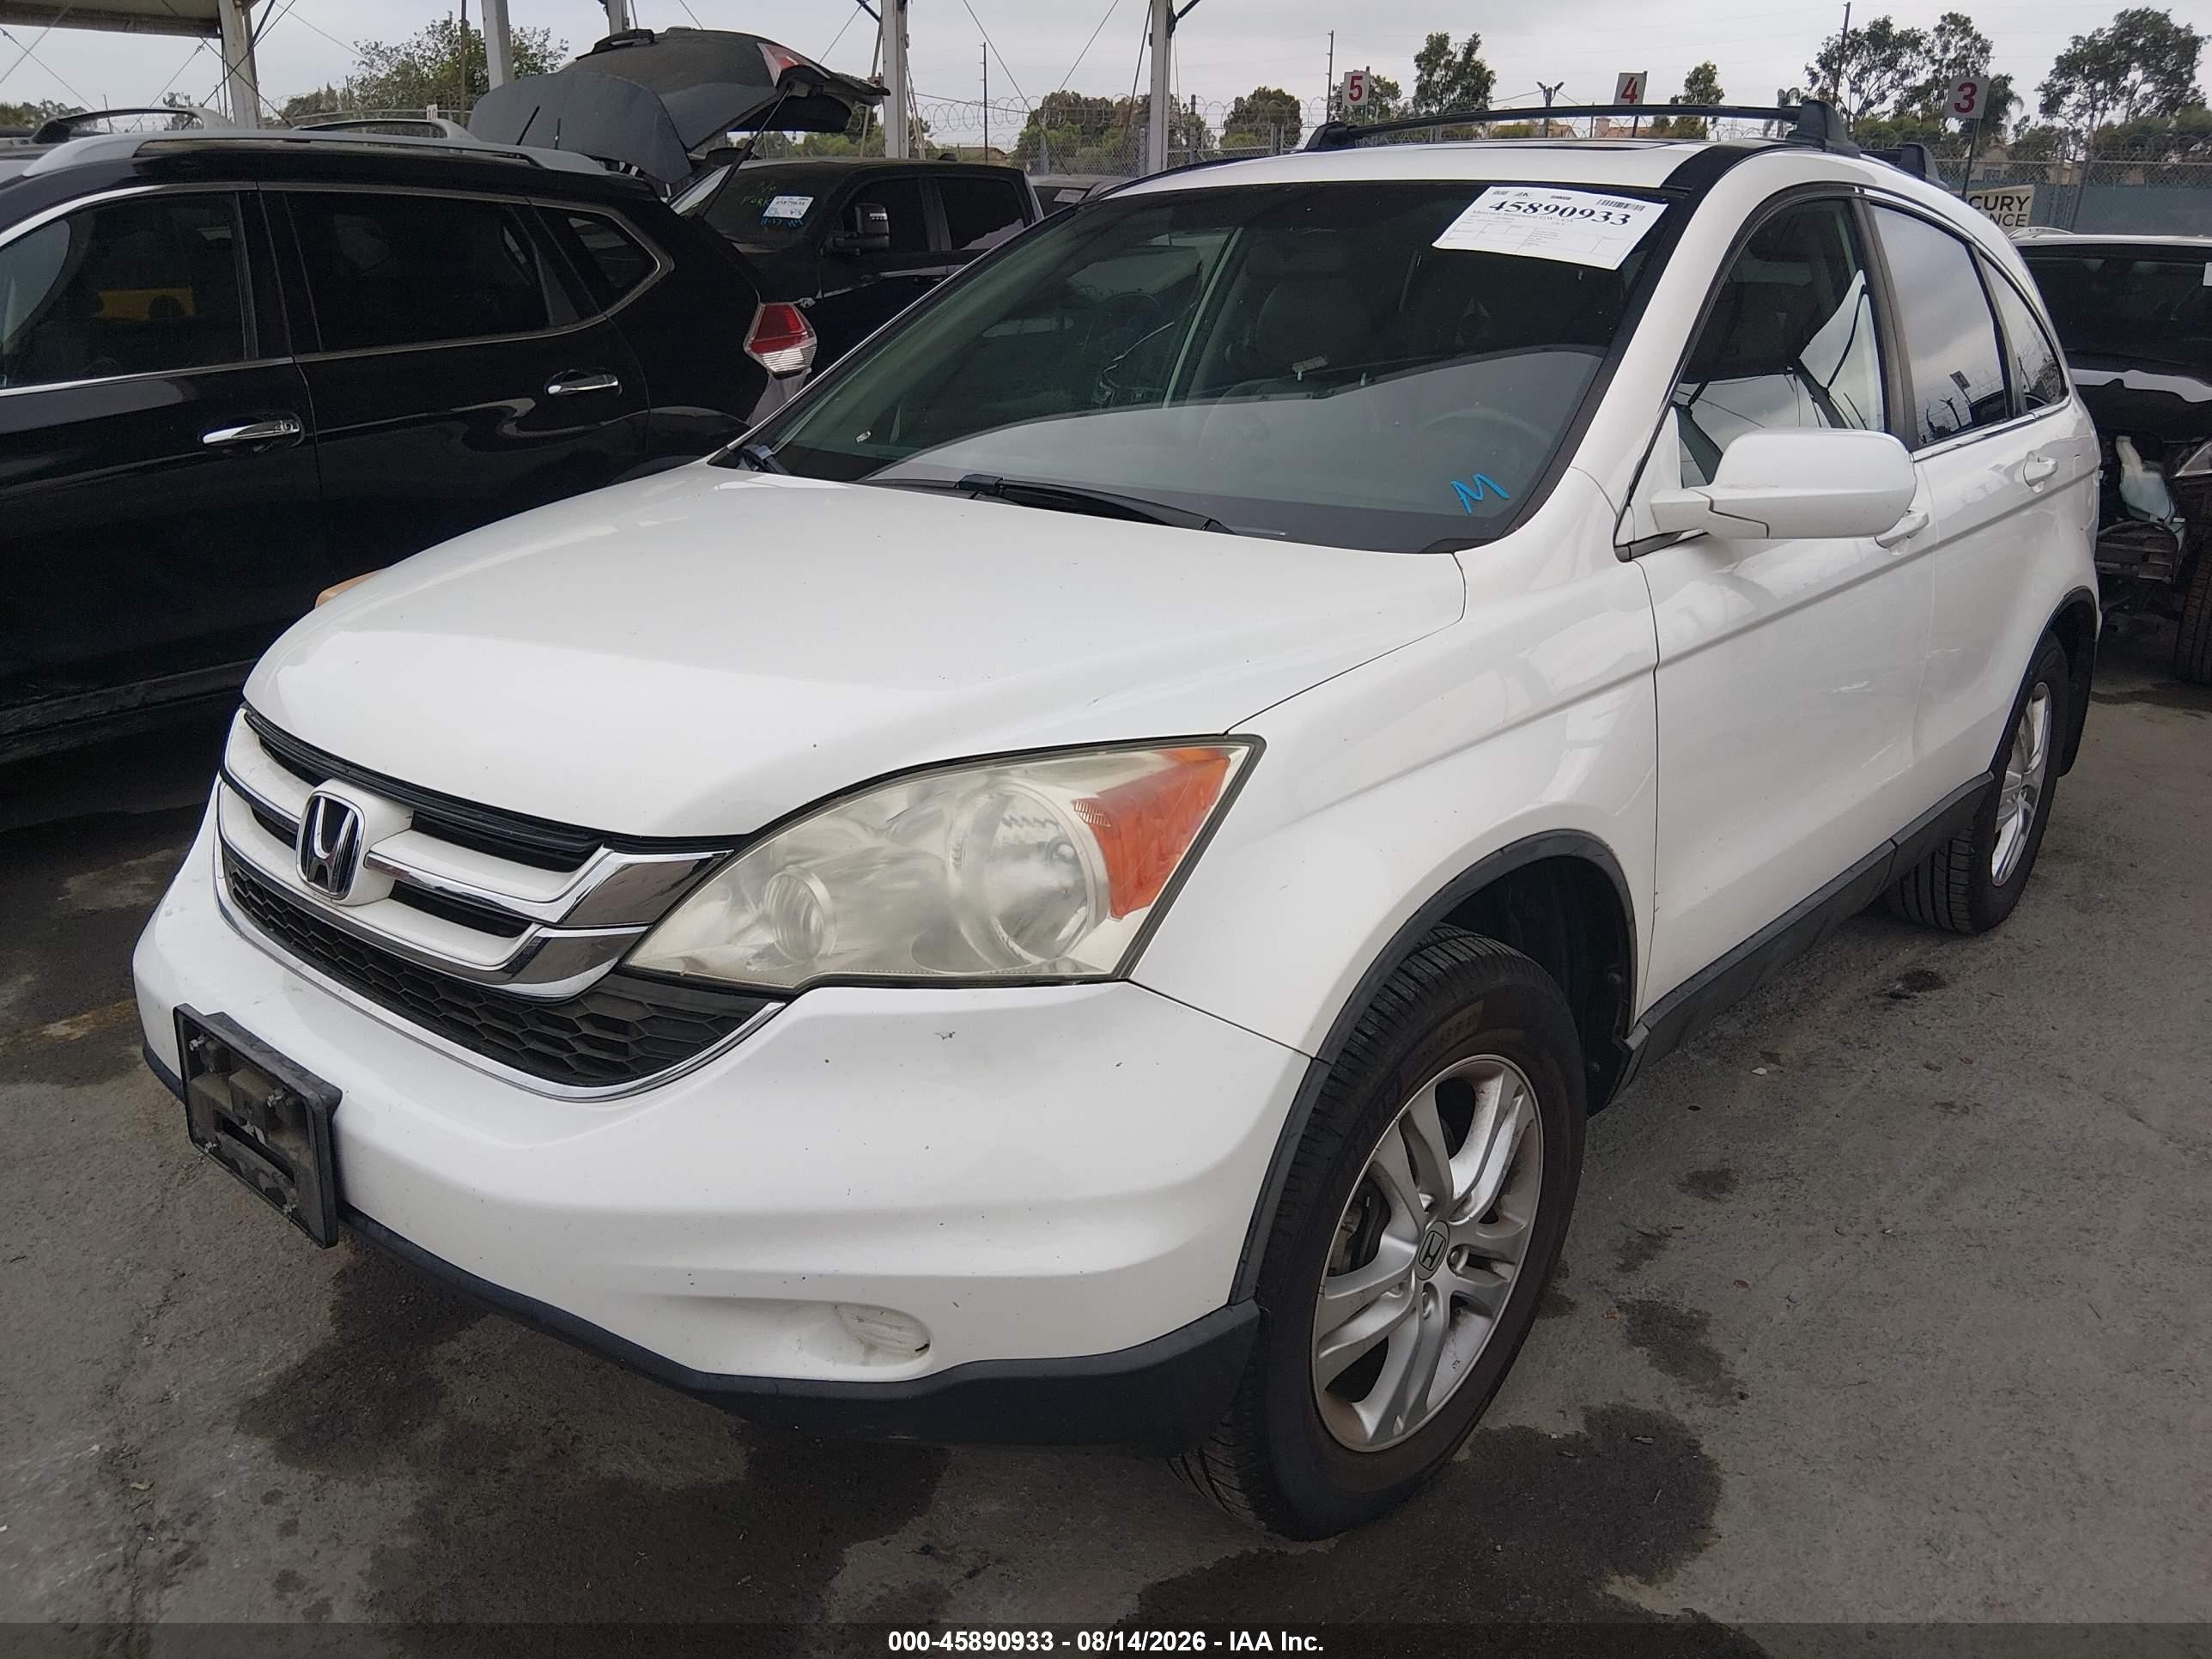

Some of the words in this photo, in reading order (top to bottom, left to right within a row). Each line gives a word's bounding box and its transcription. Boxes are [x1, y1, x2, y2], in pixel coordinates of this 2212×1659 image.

[1349, 76, 1363, 101] 5
[1620, 77, 1638, 105] 4
[1954, 82, 1978, 113] 3
[1488, 200, 1632, 226] 45890933
[1967, 196, 2030, 211] CURY
[1989, 213, 2027, 228] NCE
[1450, 473, 1510, 515] M
